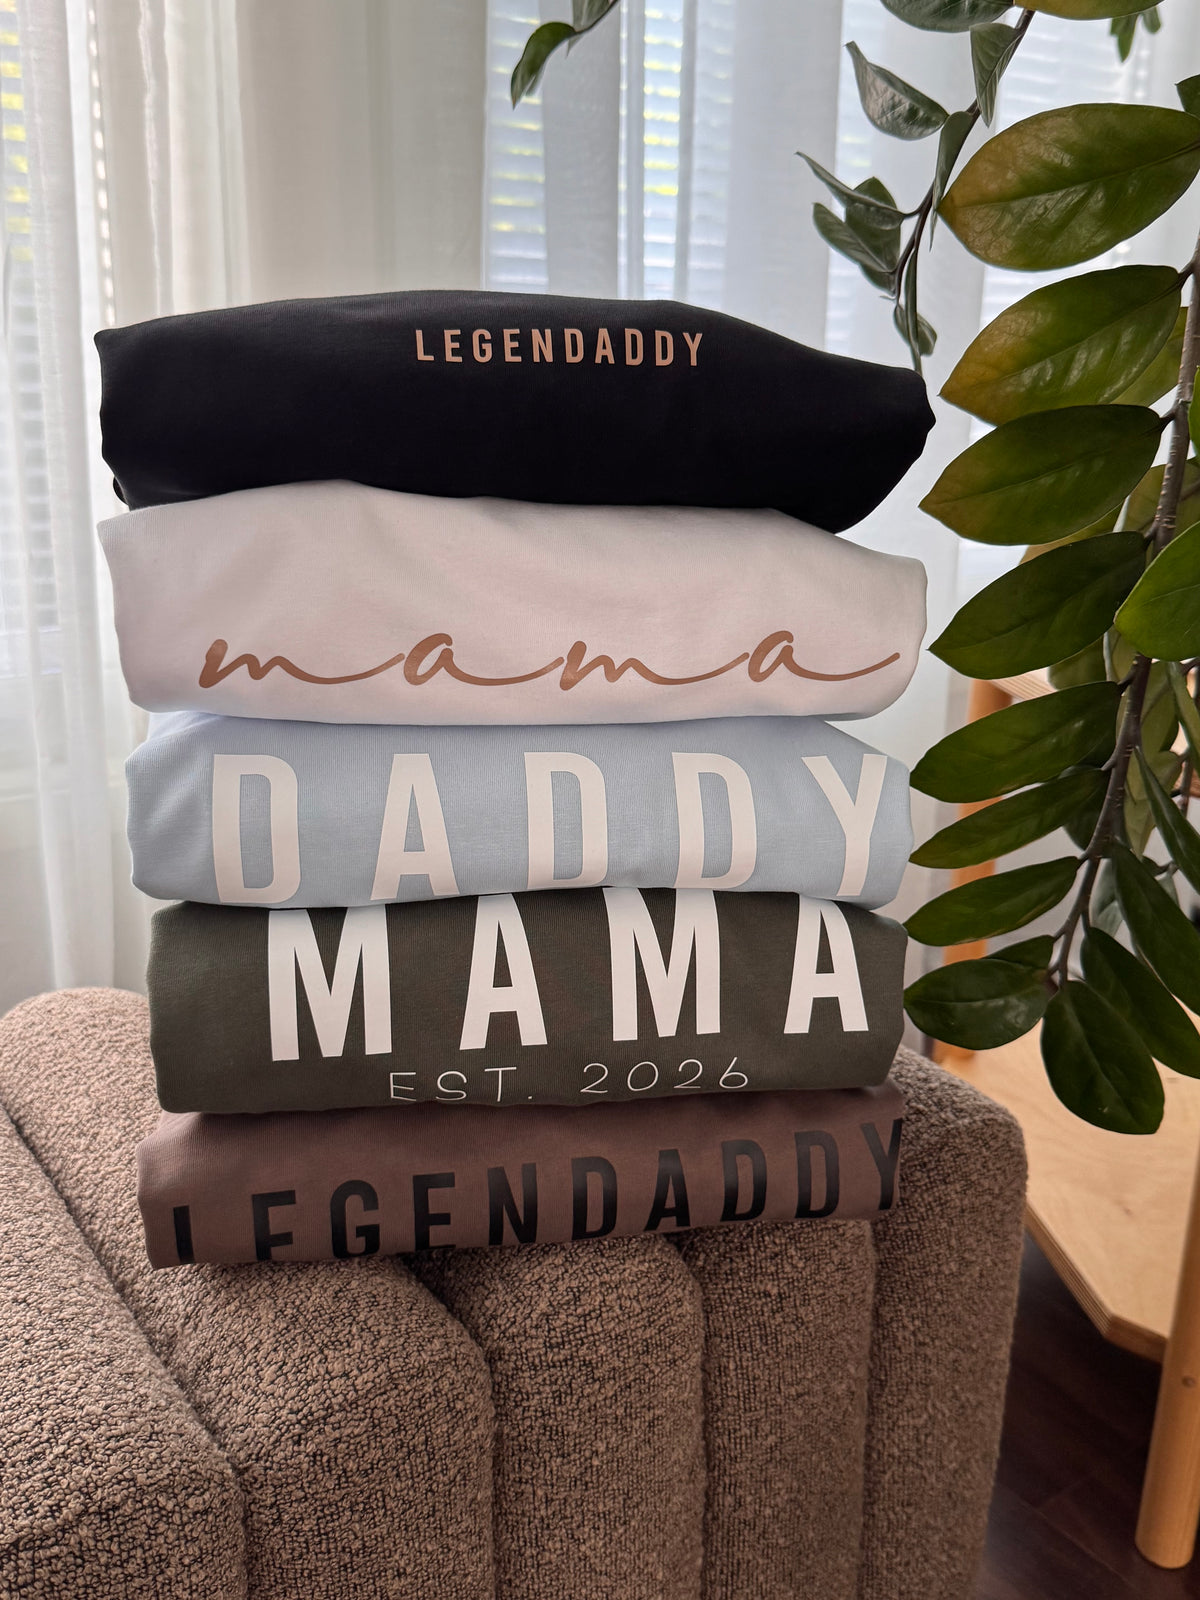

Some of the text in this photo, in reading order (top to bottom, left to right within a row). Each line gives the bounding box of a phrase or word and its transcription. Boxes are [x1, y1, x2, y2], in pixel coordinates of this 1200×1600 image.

[415, 328, 703, 366] LEGENDADDY
[199, 631, 901, 691] mama
[212, 752, 888, 905] DADDY
[268, 887, 869, 1062] MAMA
[389, 1056, 749, 1102] EST. 2026
